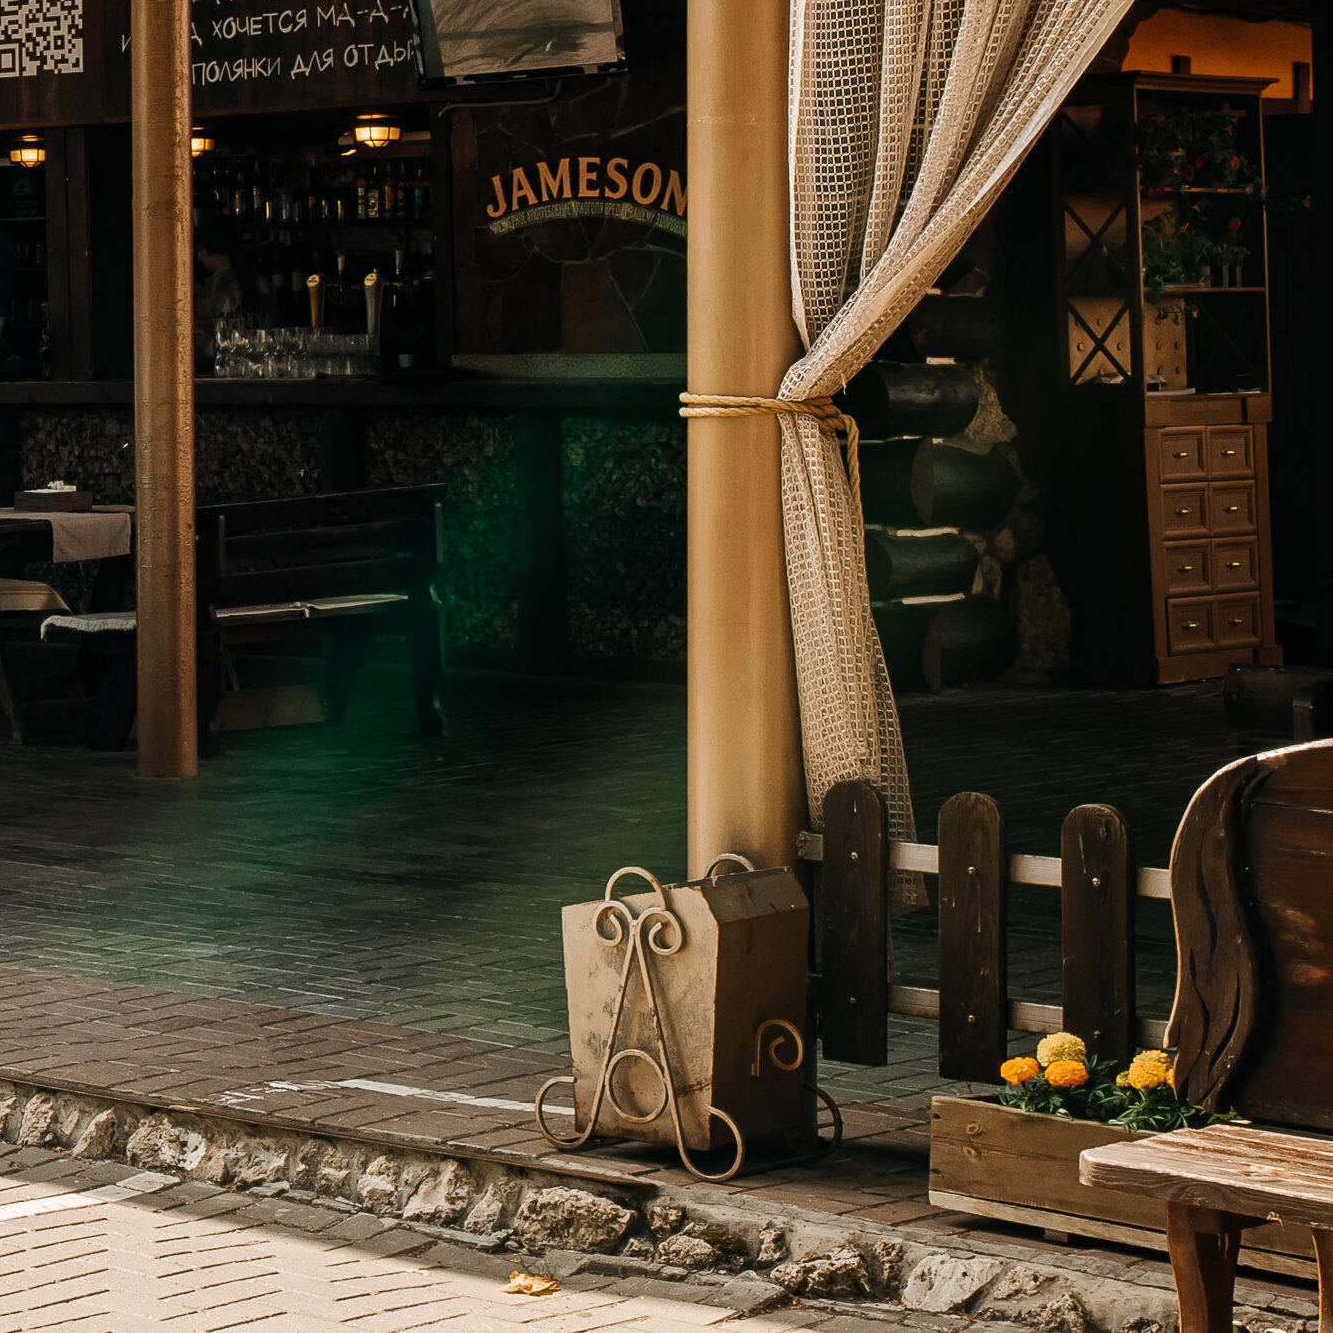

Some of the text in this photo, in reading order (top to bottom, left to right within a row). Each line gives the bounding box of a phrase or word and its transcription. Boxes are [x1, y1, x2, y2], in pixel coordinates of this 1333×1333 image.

[212, 9, 307, 40] ХОЧЕТСЯ
[291, 48, 334, 80] ДЛЯ
[344, 38, 415, 71] ОТДЫ
[486, 156, 687, 219] JAMESON
